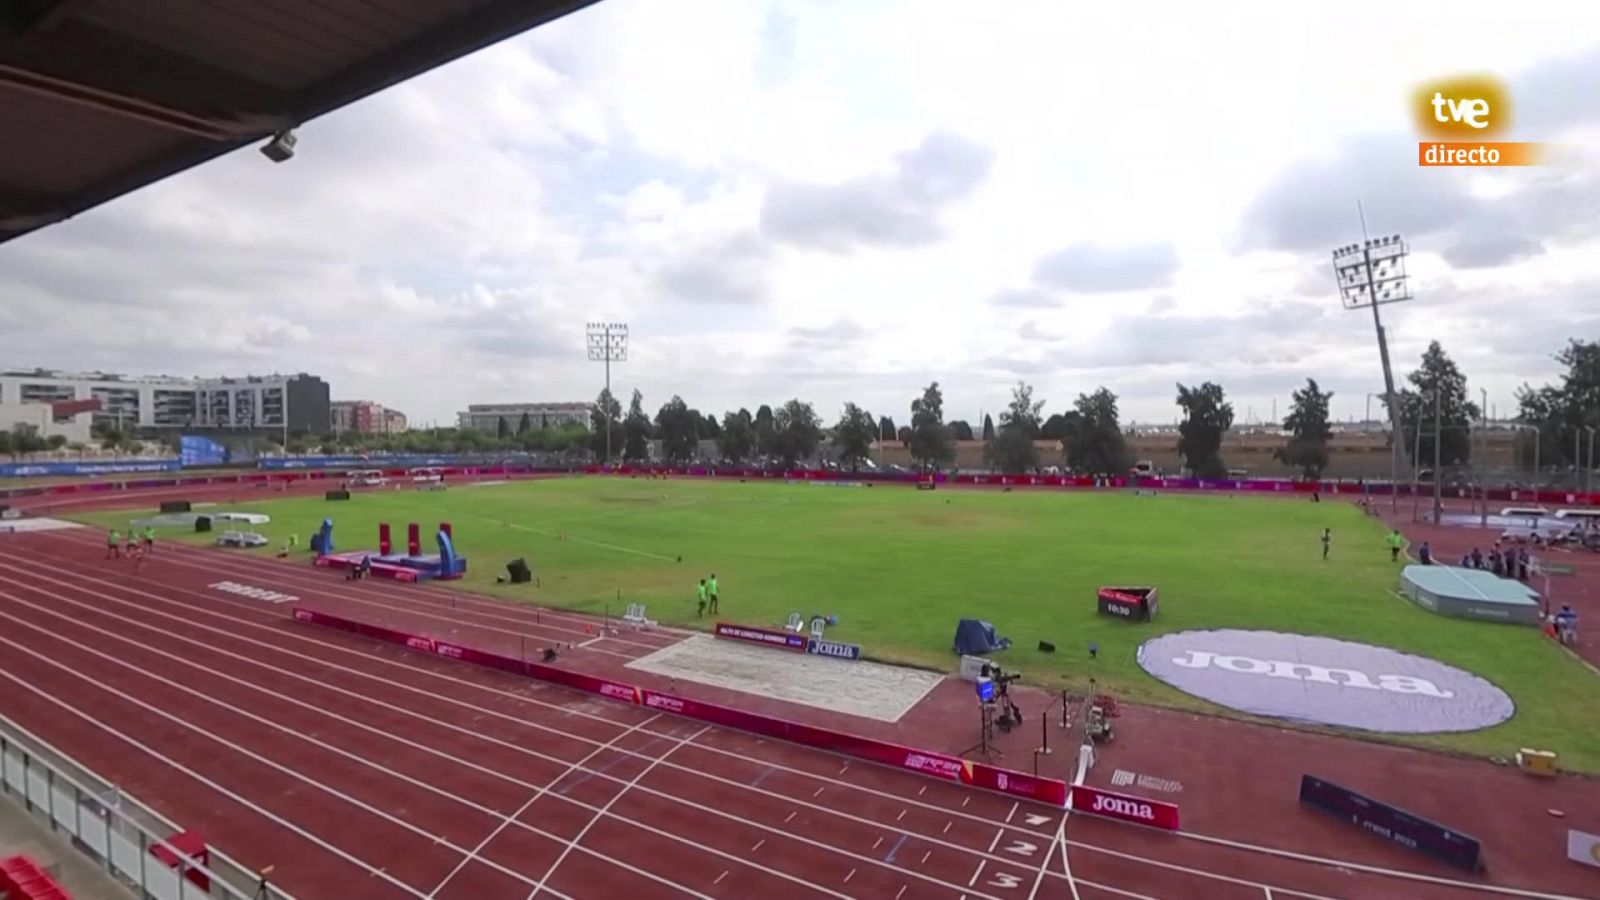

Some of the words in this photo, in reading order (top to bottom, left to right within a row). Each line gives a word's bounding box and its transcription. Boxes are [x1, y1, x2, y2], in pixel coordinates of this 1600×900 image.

[1107, 603, 1130, 616] 10:30
[1171, 649, 1455, 699] Joma
[1093, 794, 1155, 820] Joma
[1024, 813, 1053, 826] 1
[1005, 840, 1038, 856] 2
[987, 872, 1023, 888] 3
